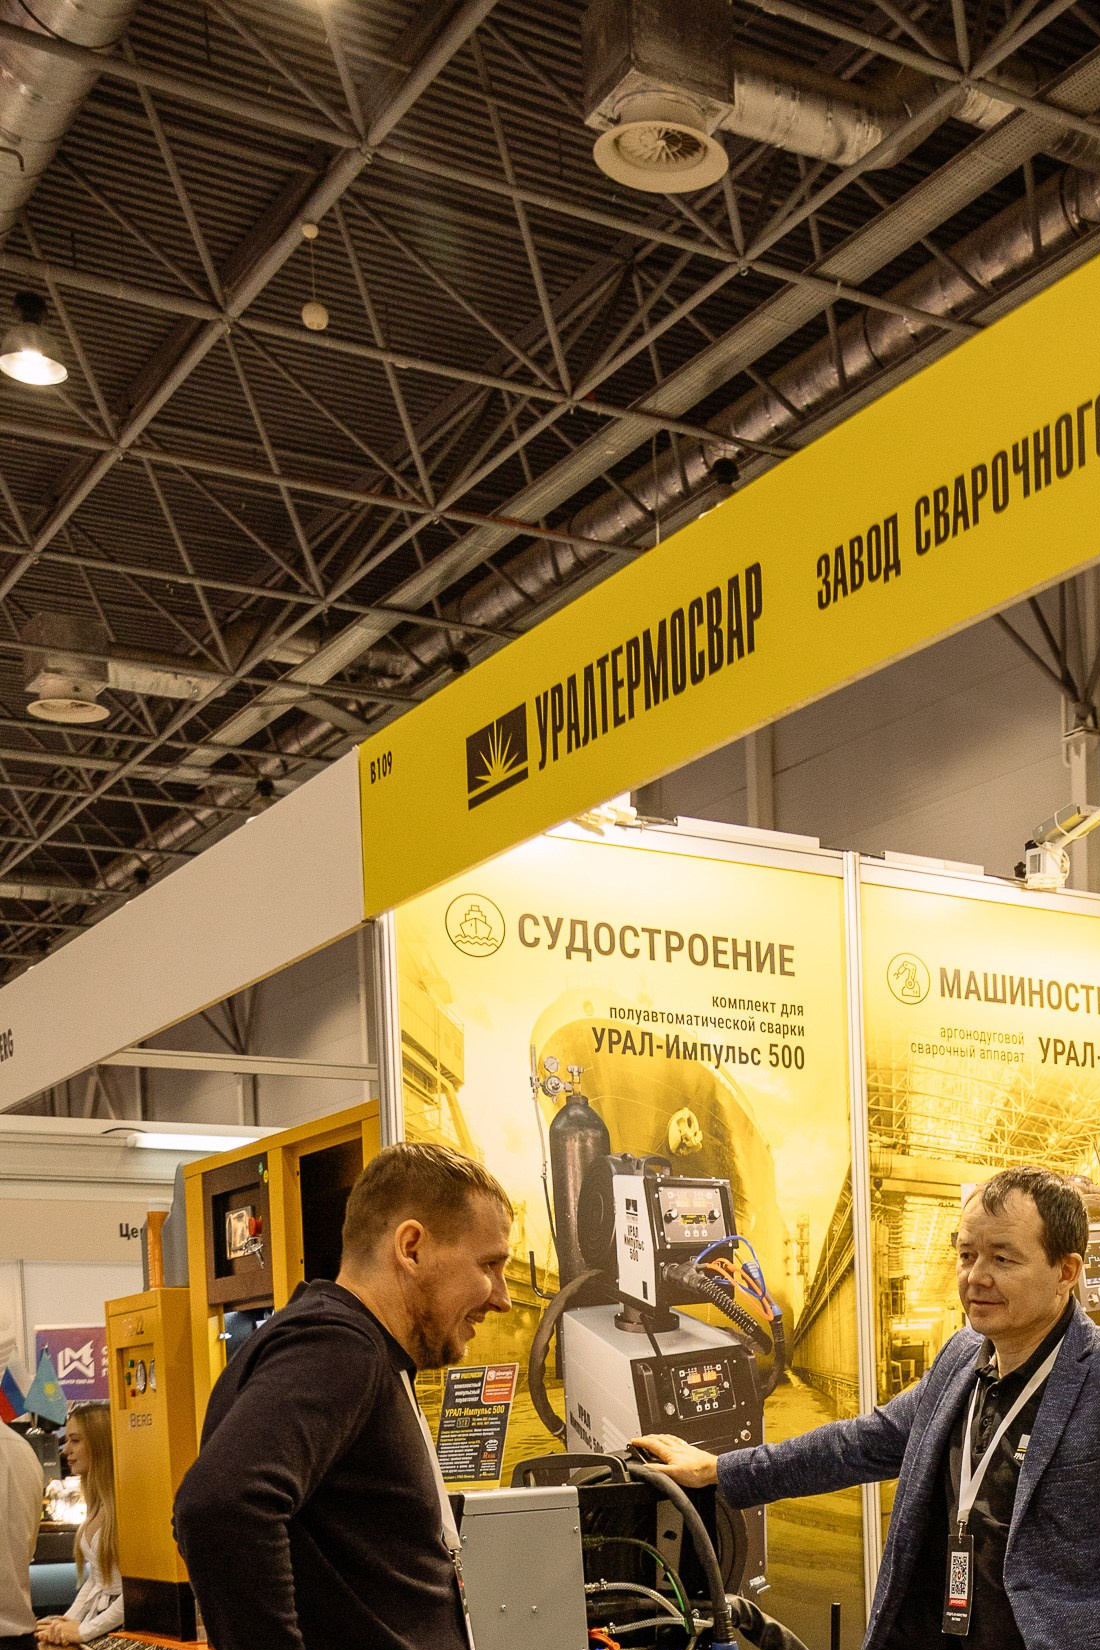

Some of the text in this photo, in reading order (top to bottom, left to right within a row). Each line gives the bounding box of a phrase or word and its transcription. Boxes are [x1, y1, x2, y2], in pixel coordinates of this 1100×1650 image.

[816, 512, 901, 611] ЗАВОД
[535, 561, 763, 771] УРАЛТЕРМОСВАР
[518, 913, 796, 977] СУДОСТРОЕНИЕ
[610, 1005, 805, 1038] полуавтоматической сварки
[712, 995, 804, 1017] комплект для
[592, 1027, 805, 1070] УРАЛ-Импульс 500
[911, 1041, 1025, 1064] сварочный аппарат
[940, 1026, 1024, 1046] аргонодуговой
[493, 1405, 505, 1414] 500
